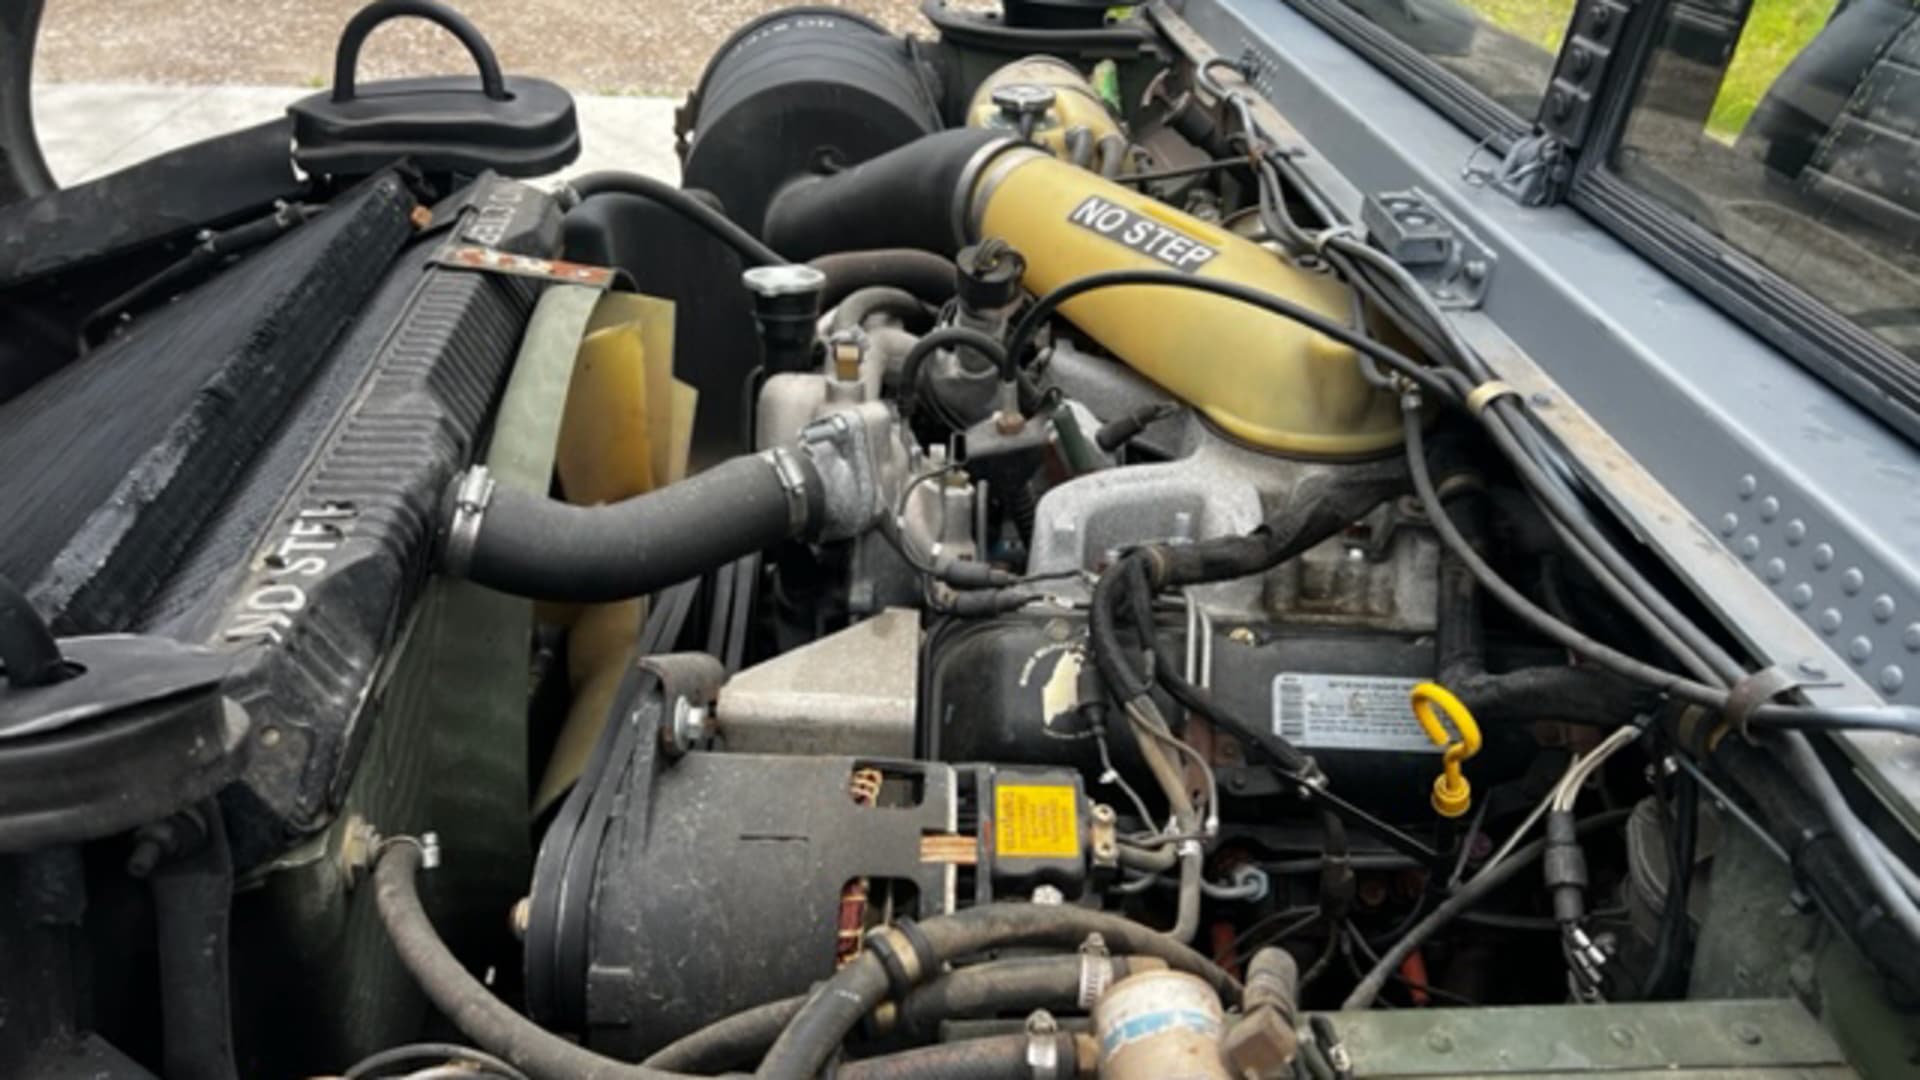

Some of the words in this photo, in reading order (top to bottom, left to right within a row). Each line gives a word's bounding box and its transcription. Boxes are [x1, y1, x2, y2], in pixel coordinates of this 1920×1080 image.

[1073, 197, 1127, 232] NO
[1122, 220, 1214, 266] STEP
[225, 584, 306, 643] NO
